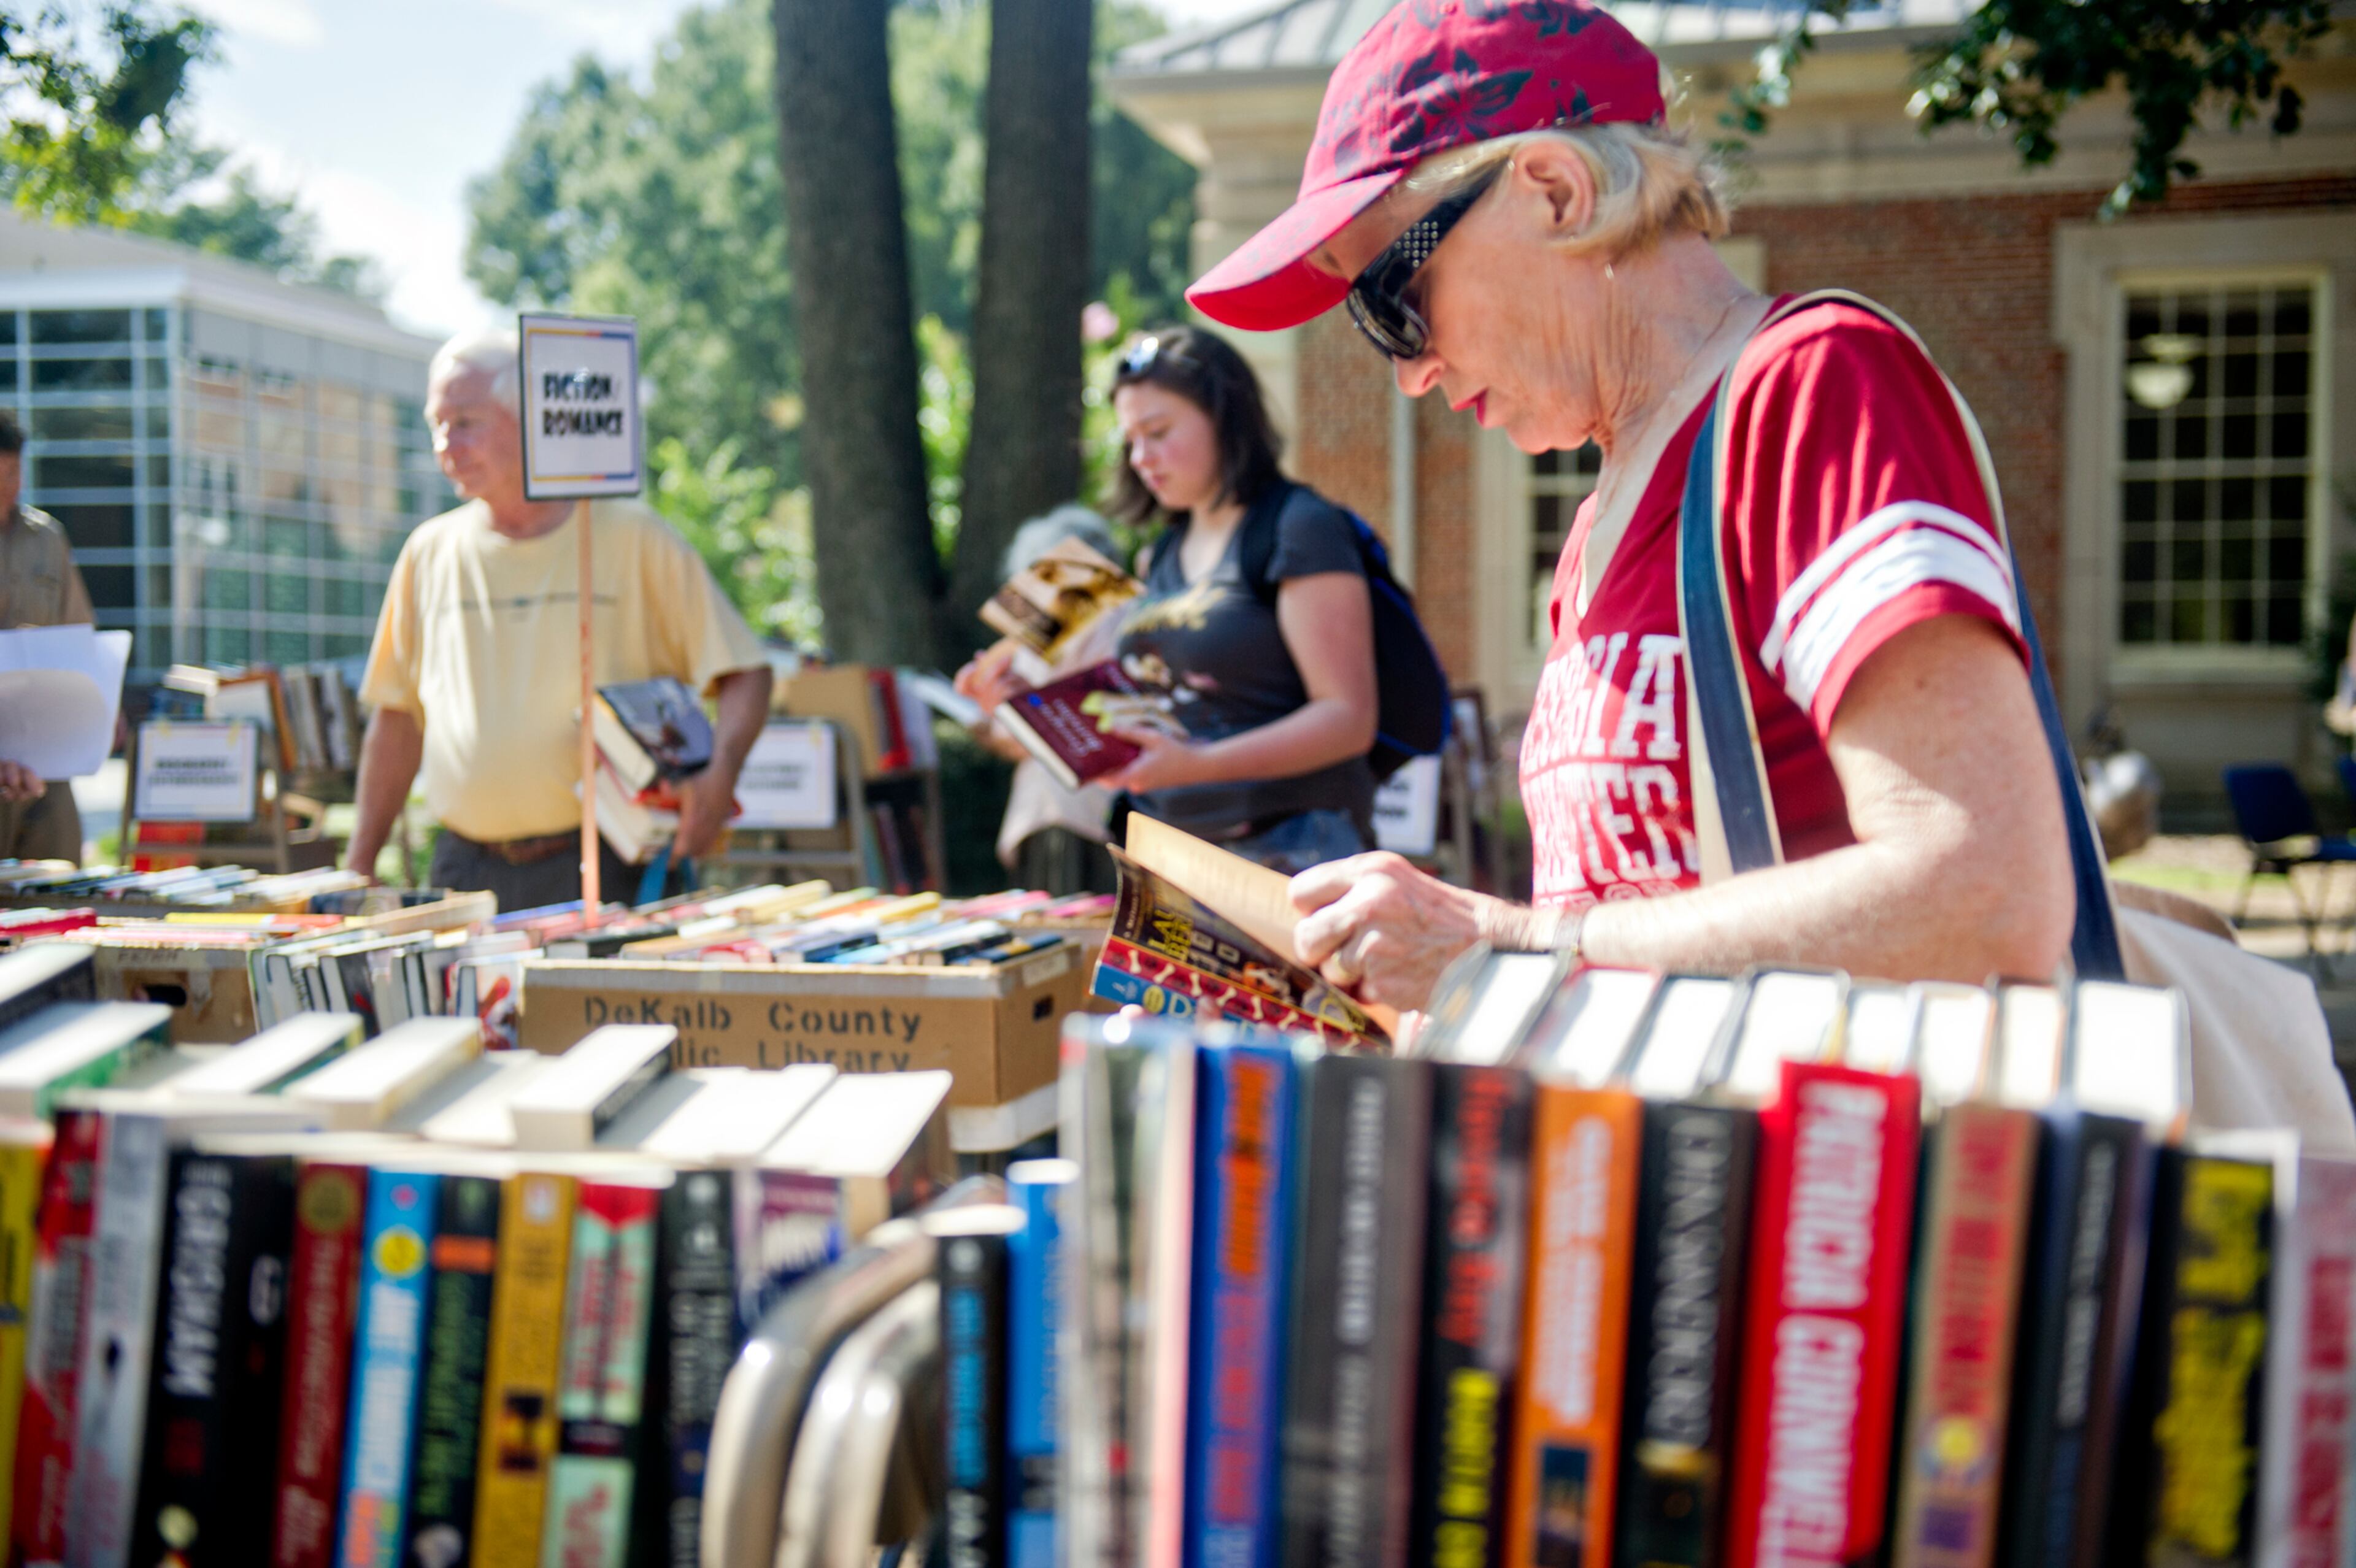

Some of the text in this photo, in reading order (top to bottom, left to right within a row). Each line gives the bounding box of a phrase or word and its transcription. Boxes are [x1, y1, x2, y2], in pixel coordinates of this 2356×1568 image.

[544, 373, 611, 401] FICTION
[543, 409, 623, 436] ROMANCE
[585, 996, 921, 1043] DeKalb County
[758, 1040, 909, 1072] Library
[162, 1185, 233, 1399] GRISHAM
[1756, 1080, 1887, 1568] PATRICIA CORNWEL
